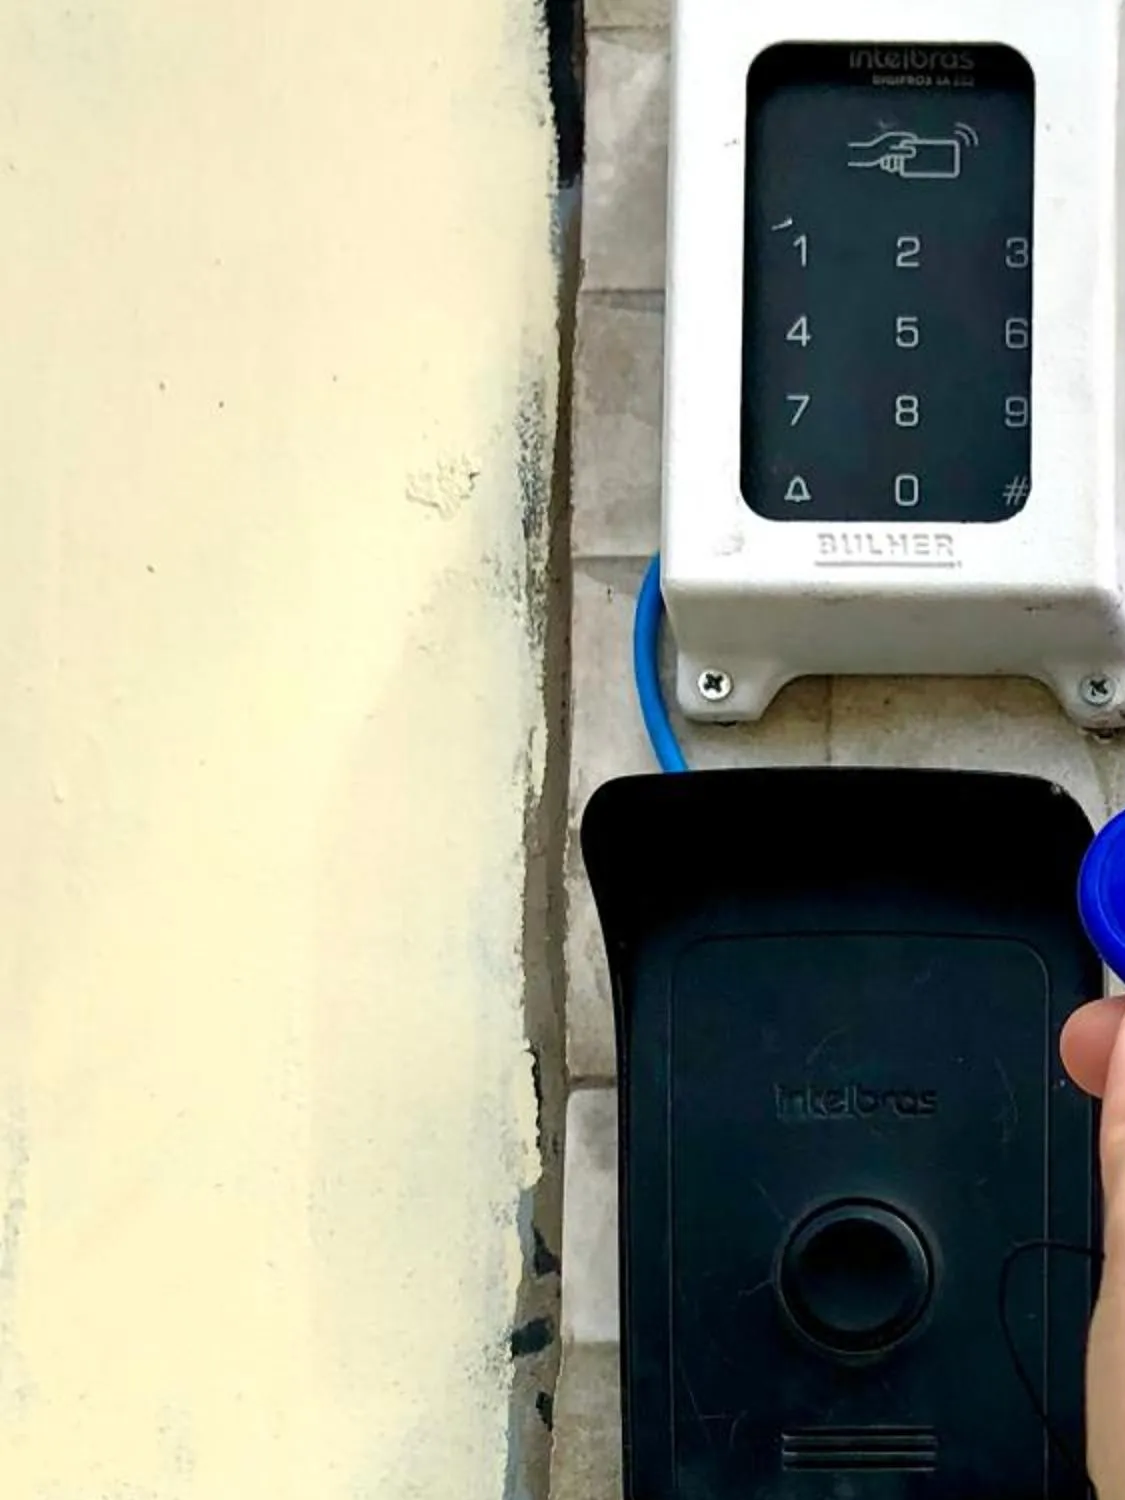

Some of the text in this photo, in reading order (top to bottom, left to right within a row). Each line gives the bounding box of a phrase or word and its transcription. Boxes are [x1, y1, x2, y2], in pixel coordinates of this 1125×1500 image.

[848, 47, 976, 71] intelbras
[793, 235, 1029, 268] 1 2 3
[786, 315, 1028, 349] 4 5 6
[787, 394, 1028, 427] 7 8 9
[894, 474, 919, 507] 0
[817, 532, 955, 557] BULHER
